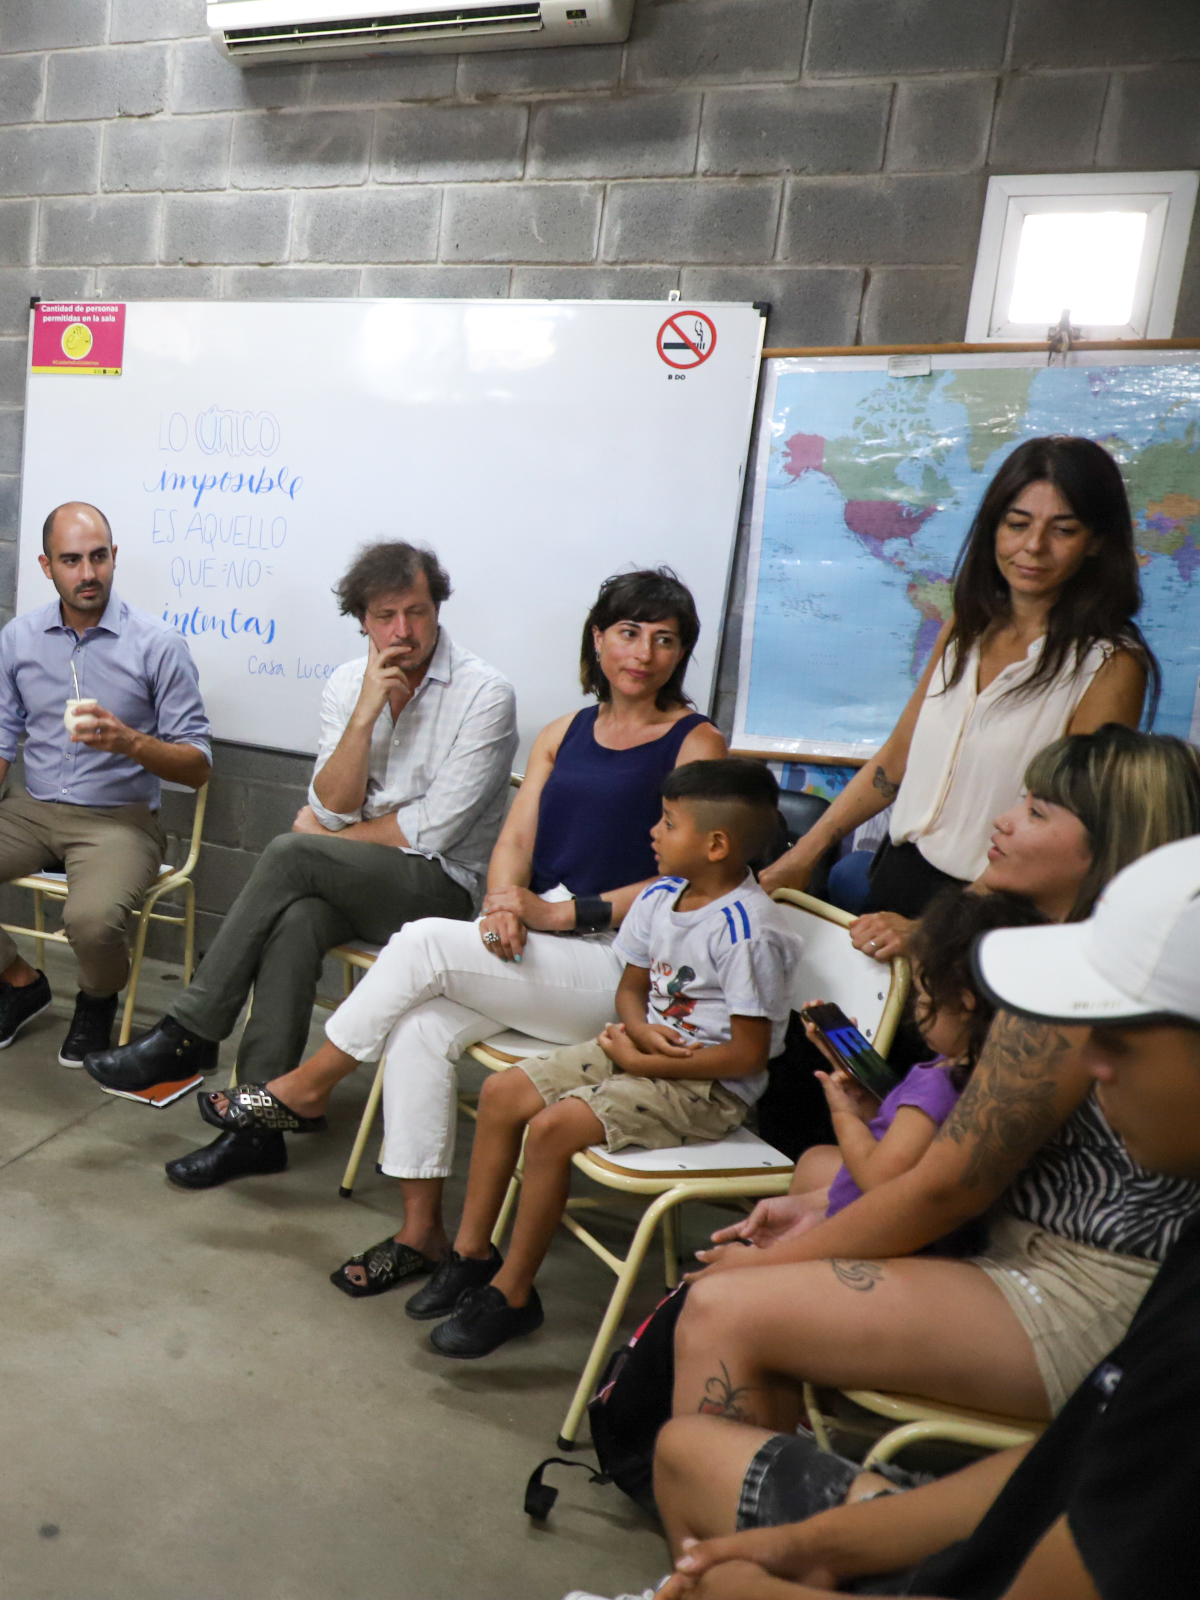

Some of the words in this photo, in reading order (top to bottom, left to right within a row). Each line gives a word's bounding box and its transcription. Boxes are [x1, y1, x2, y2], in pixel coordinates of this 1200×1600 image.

[42, 315, 80, 323] permitidas
[85, 305, 119, 313] personas
[159, 411, 188, 452] LO
[143, 463, 303, 508] imposible
[152, 508, 178, 544] ES
[184, 512, 287, 552] AQUELLO
[171, 556, 217, 598] QUE
[227, 558, 262, 589] NO
[162, 602, 275, 644] intentas
[248, 655, 286, 677] Casa
[296, 657, 340, 679] Lucer
